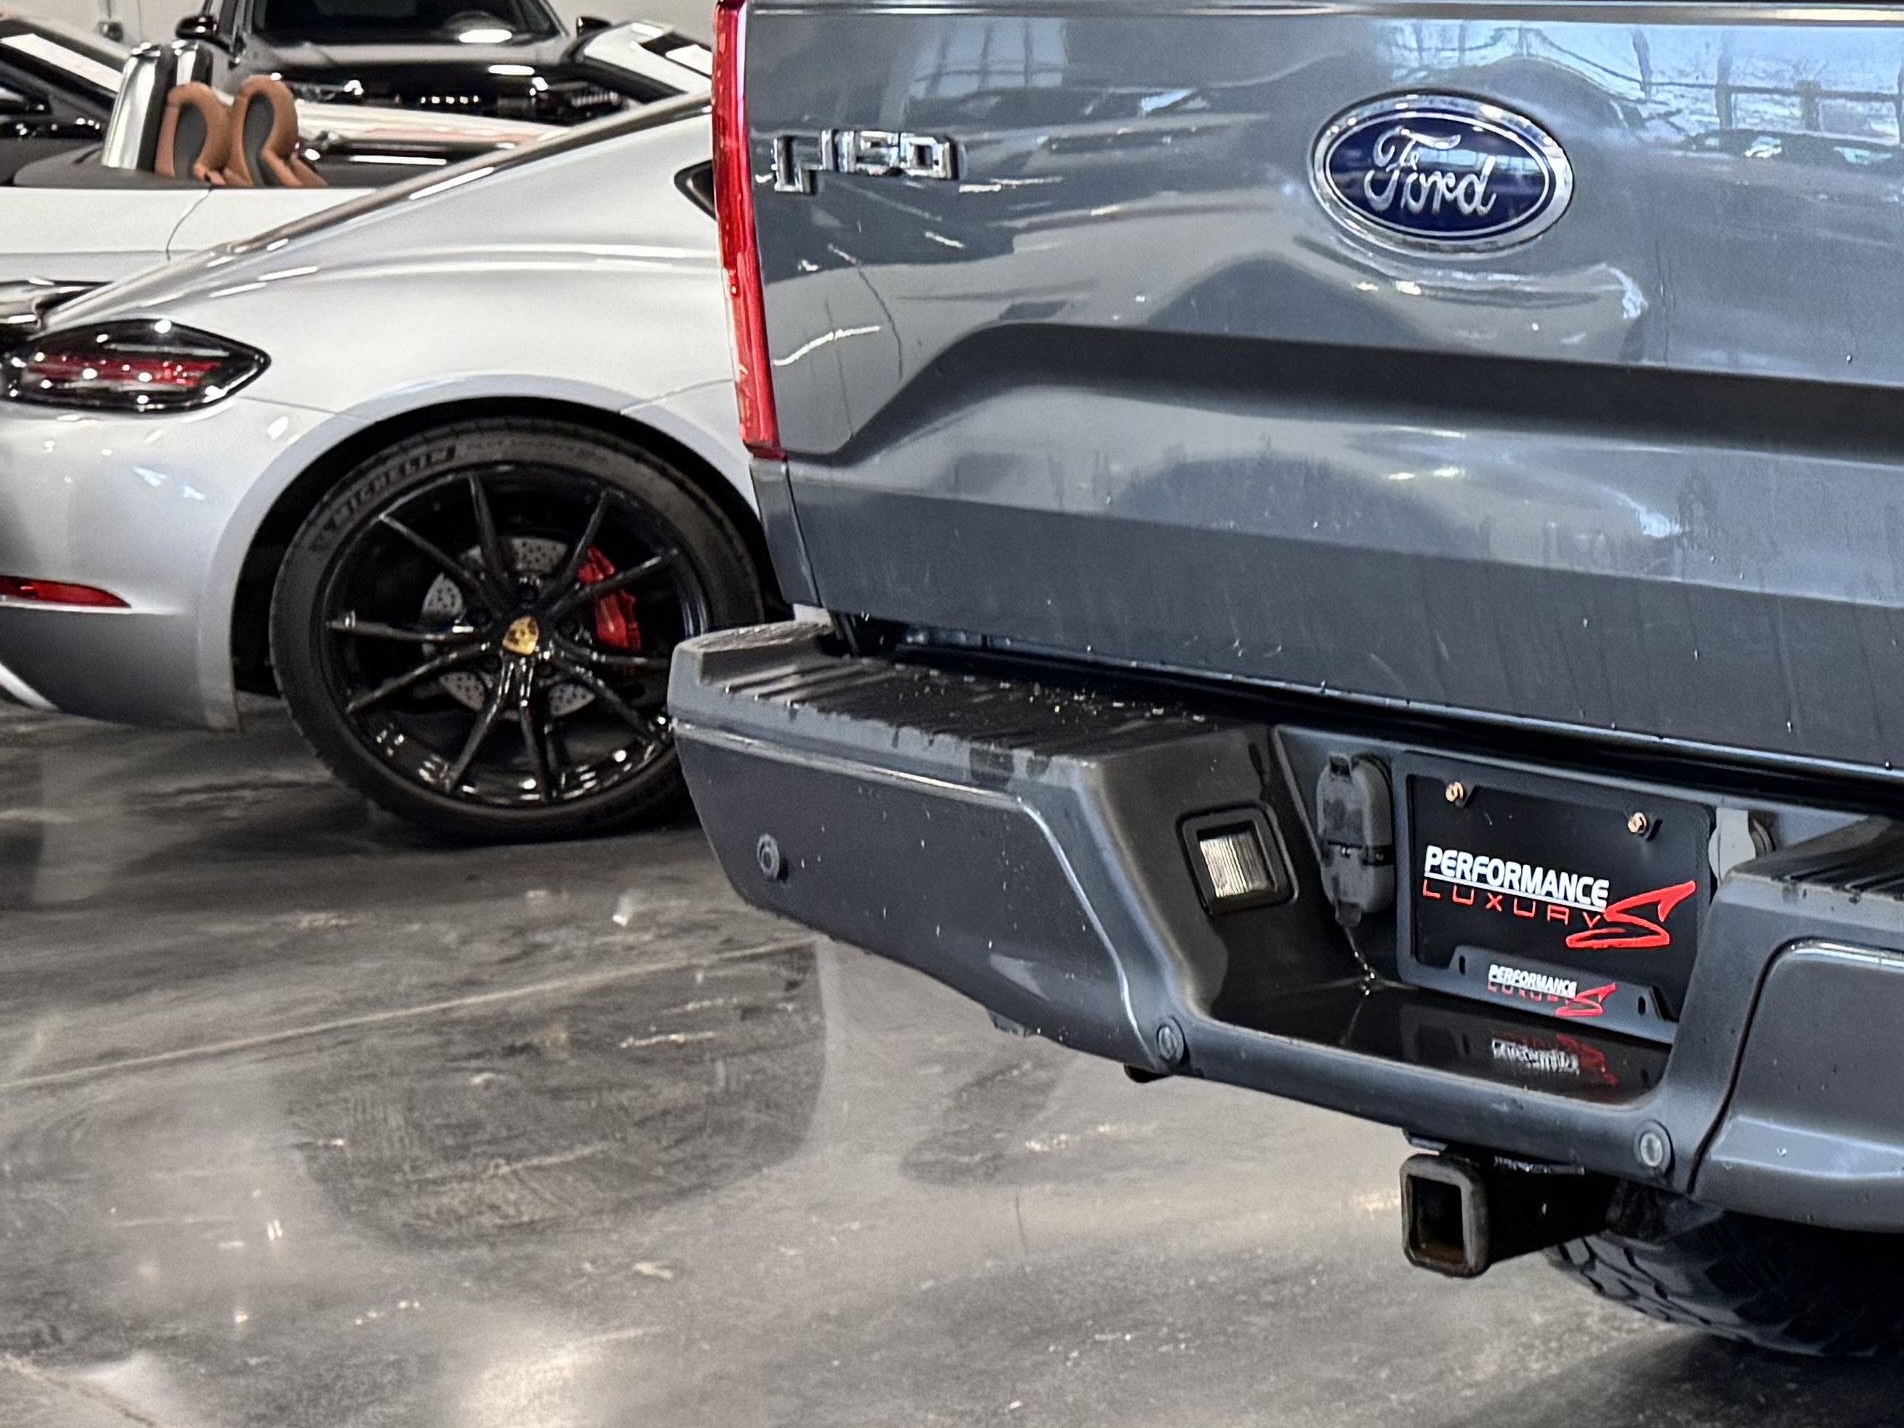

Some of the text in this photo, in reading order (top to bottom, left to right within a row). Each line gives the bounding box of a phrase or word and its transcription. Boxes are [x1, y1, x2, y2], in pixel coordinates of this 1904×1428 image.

[1363, 126, 1498, 216] Ford
[331, 445, 457, 529] MICHELIN
[1422, 878, 1602, 929] LUXURY
[1425, 845, 1609, 907] PERFORMANCE
[1487, 980, 1572, 1005] LUU
[1488, 964, 1577, 1000] PERFORMANCE
